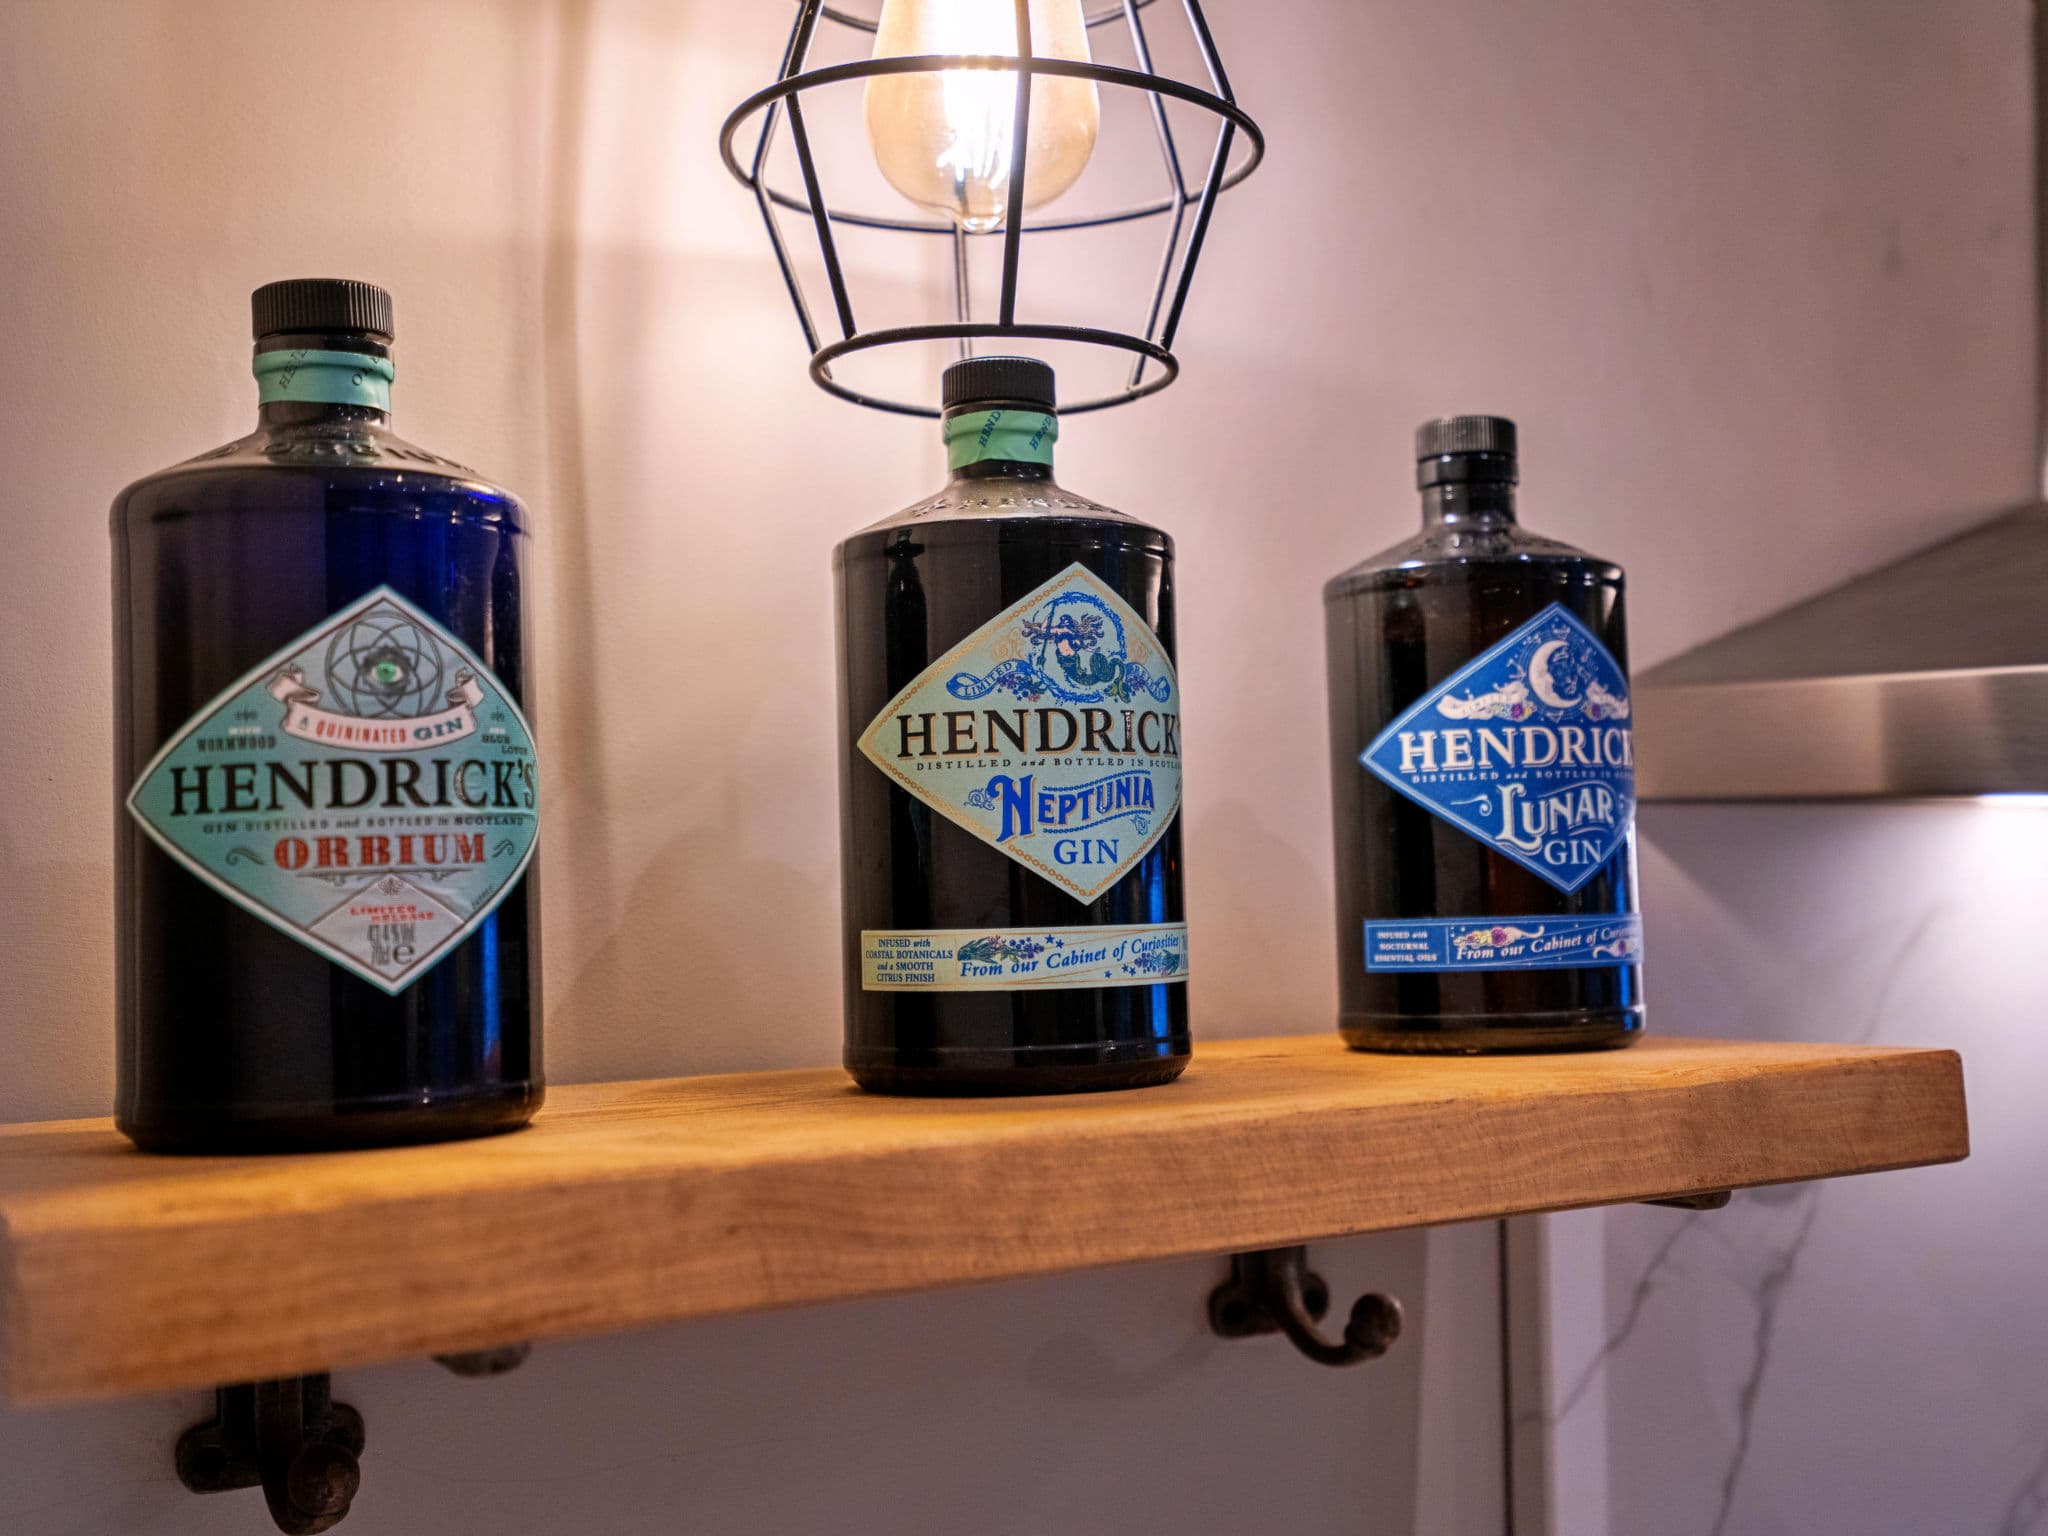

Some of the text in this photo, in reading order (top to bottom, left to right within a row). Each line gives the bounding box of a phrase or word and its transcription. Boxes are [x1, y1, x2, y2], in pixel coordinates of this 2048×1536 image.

[963, 660, 1014, 696] LIMITED
[413, 717, 463, 740] GIN
[917, 759, 1011, 771] DISTILLED
[1021, 758, 1046, 766] and
[1054, 758, 1124, 766] BOTTLED
[1131, 758, 1144, 766] IN
[170, 758, 537, 816] HENDRICK'S
[1412, 771, 1499, 784] DISTILLED
[367, 815, 432, 827] BOTTLED
[455, 812, 524, 826] SCOTLAND
[274, 832, 486, 870] ORBIUM
[1053, 839, 1119, 864] GIN
[1544, 840, 1602, 865] GIN
[865, 949, 953, 959] COASTAL BOTANICALS
[878, 938, 931, 948] INFUSED with
[1457, 945, 1494, 961] From
[1501, 945, 1525, 957] our
[1530, 938, 1582, 954] Cabinet
[1586, 928, 1599, 947] of
[895, 961, 934, 971] SMOOTH
[960, 961, 1003, 977] From
[1011, 959, 1039, 974] our
[1046, 947, 1106, 969] Cabinet
[1113, 940, 1127, 962] of
[1131, 934, 1179, 954] Curiosities
[876, 973, 935, 982] CITRUS FINISH
